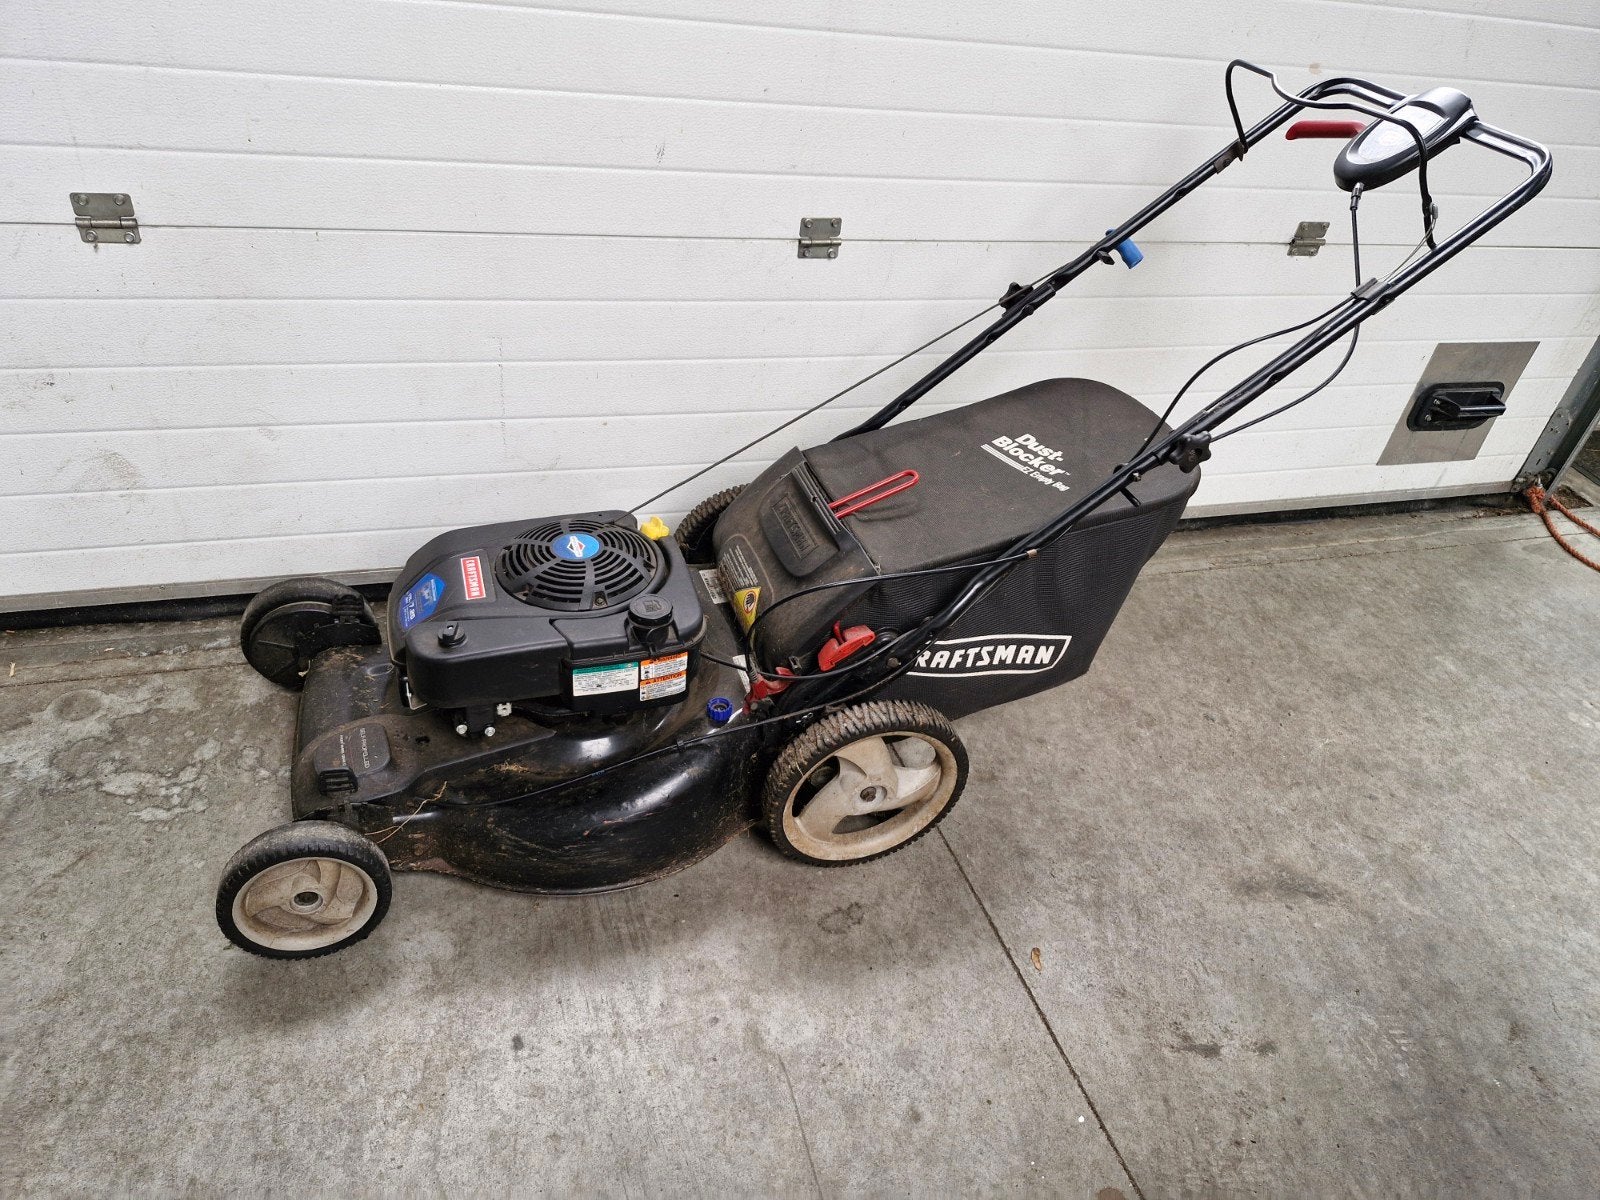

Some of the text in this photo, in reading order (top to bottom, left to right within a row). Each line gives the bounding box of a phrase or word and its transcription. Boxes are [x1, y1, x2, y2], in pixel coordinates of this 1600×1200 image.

[1014, 433, 1064, 462] Dust-
[466, 559, 480, 597] CRAFTSMAN
[915, 645, 1056, 669] RAFTSMAN
